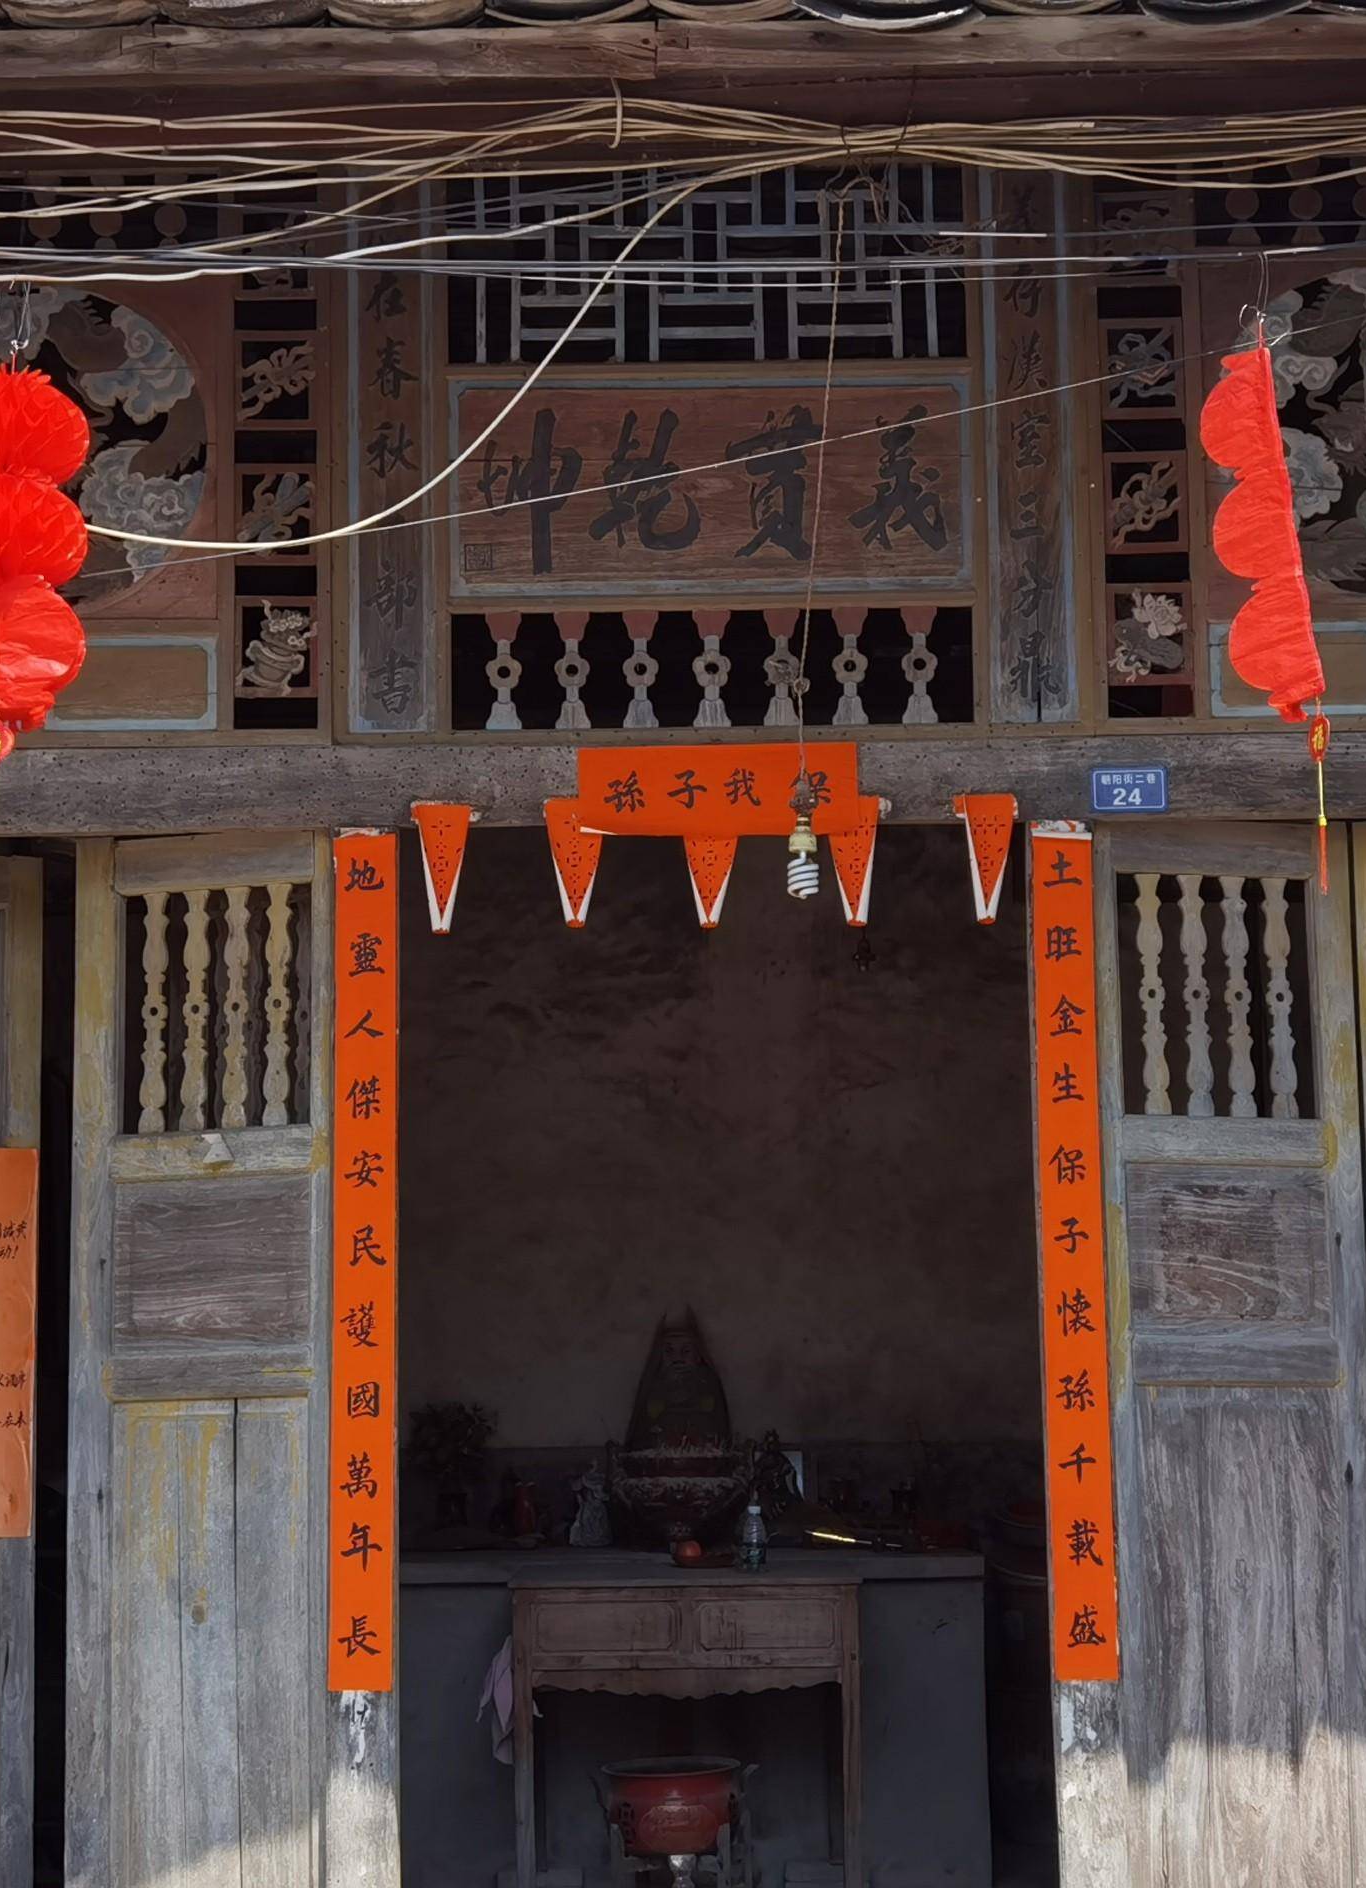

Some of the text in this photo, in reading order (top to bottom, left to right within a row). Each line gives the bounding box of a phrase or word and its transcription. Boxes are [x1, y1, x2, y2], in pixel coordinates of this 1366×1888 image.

[1113, 788, 1142, 806] 24
[338, 857, 386, 1659] 地靈人傑安民護國萬年長
[1043, 850, 1106, 1647] 土旺金生保子懷孫千載盛
